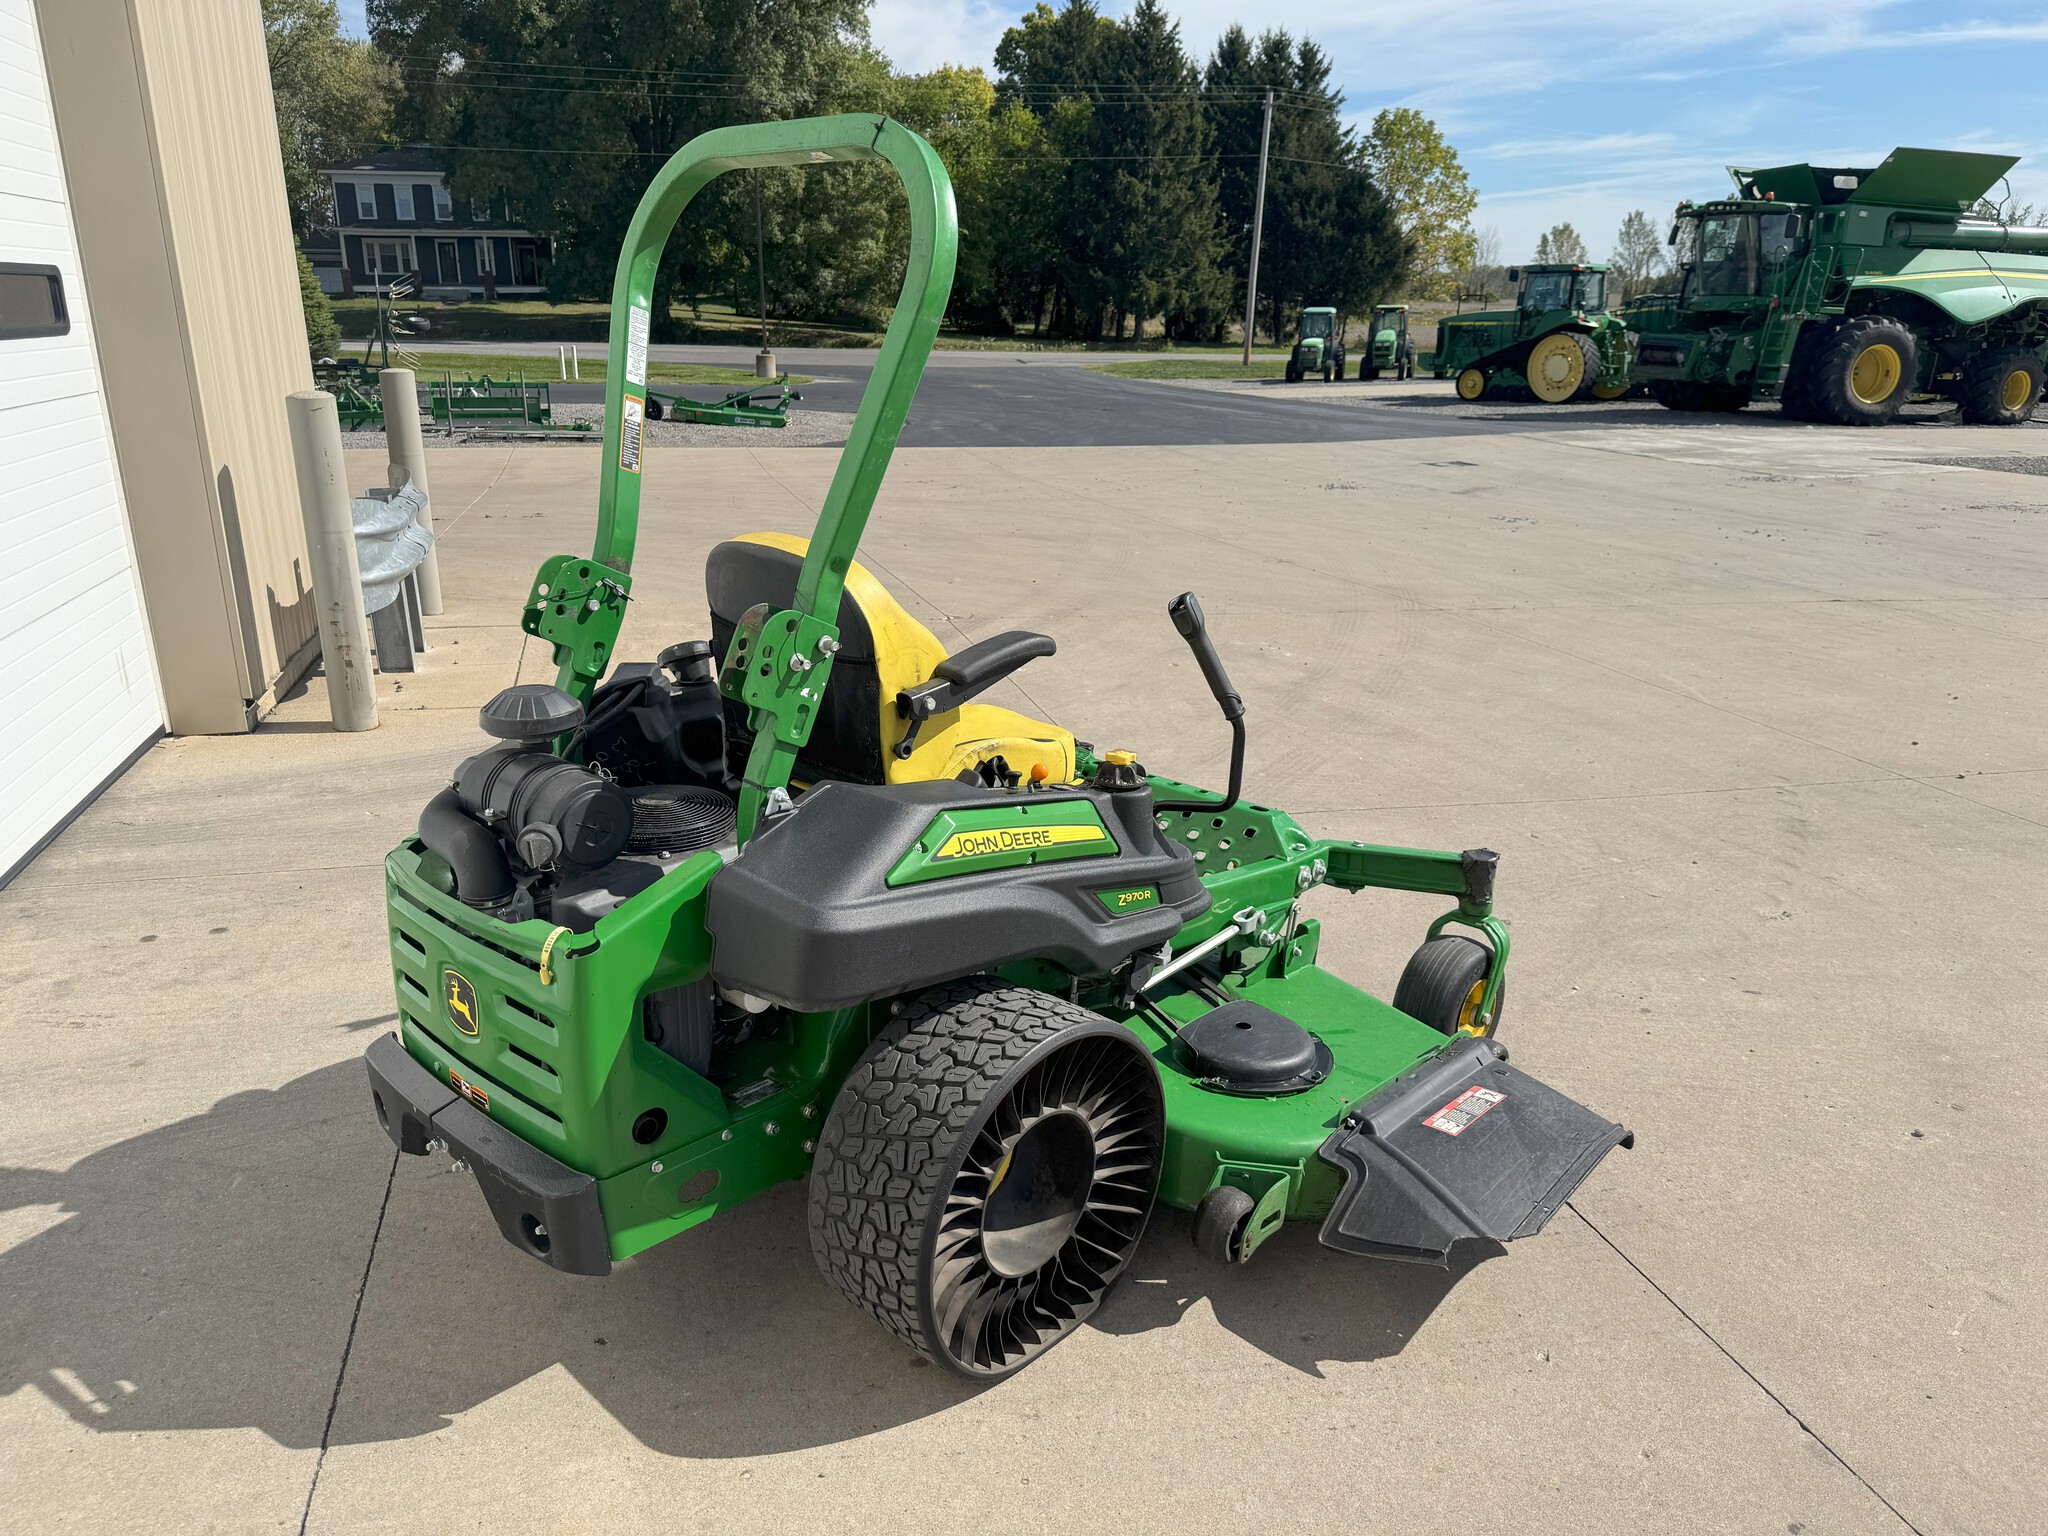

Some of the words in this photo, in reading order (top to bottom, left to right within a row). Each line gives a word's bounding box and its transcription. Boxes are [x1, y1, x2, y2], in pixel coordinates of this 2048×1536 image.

[953, 837, 998, 856] JOHN
[999, 830, 1054, 848] DEERE
[1117, 890, 1151, 907] Z970R
